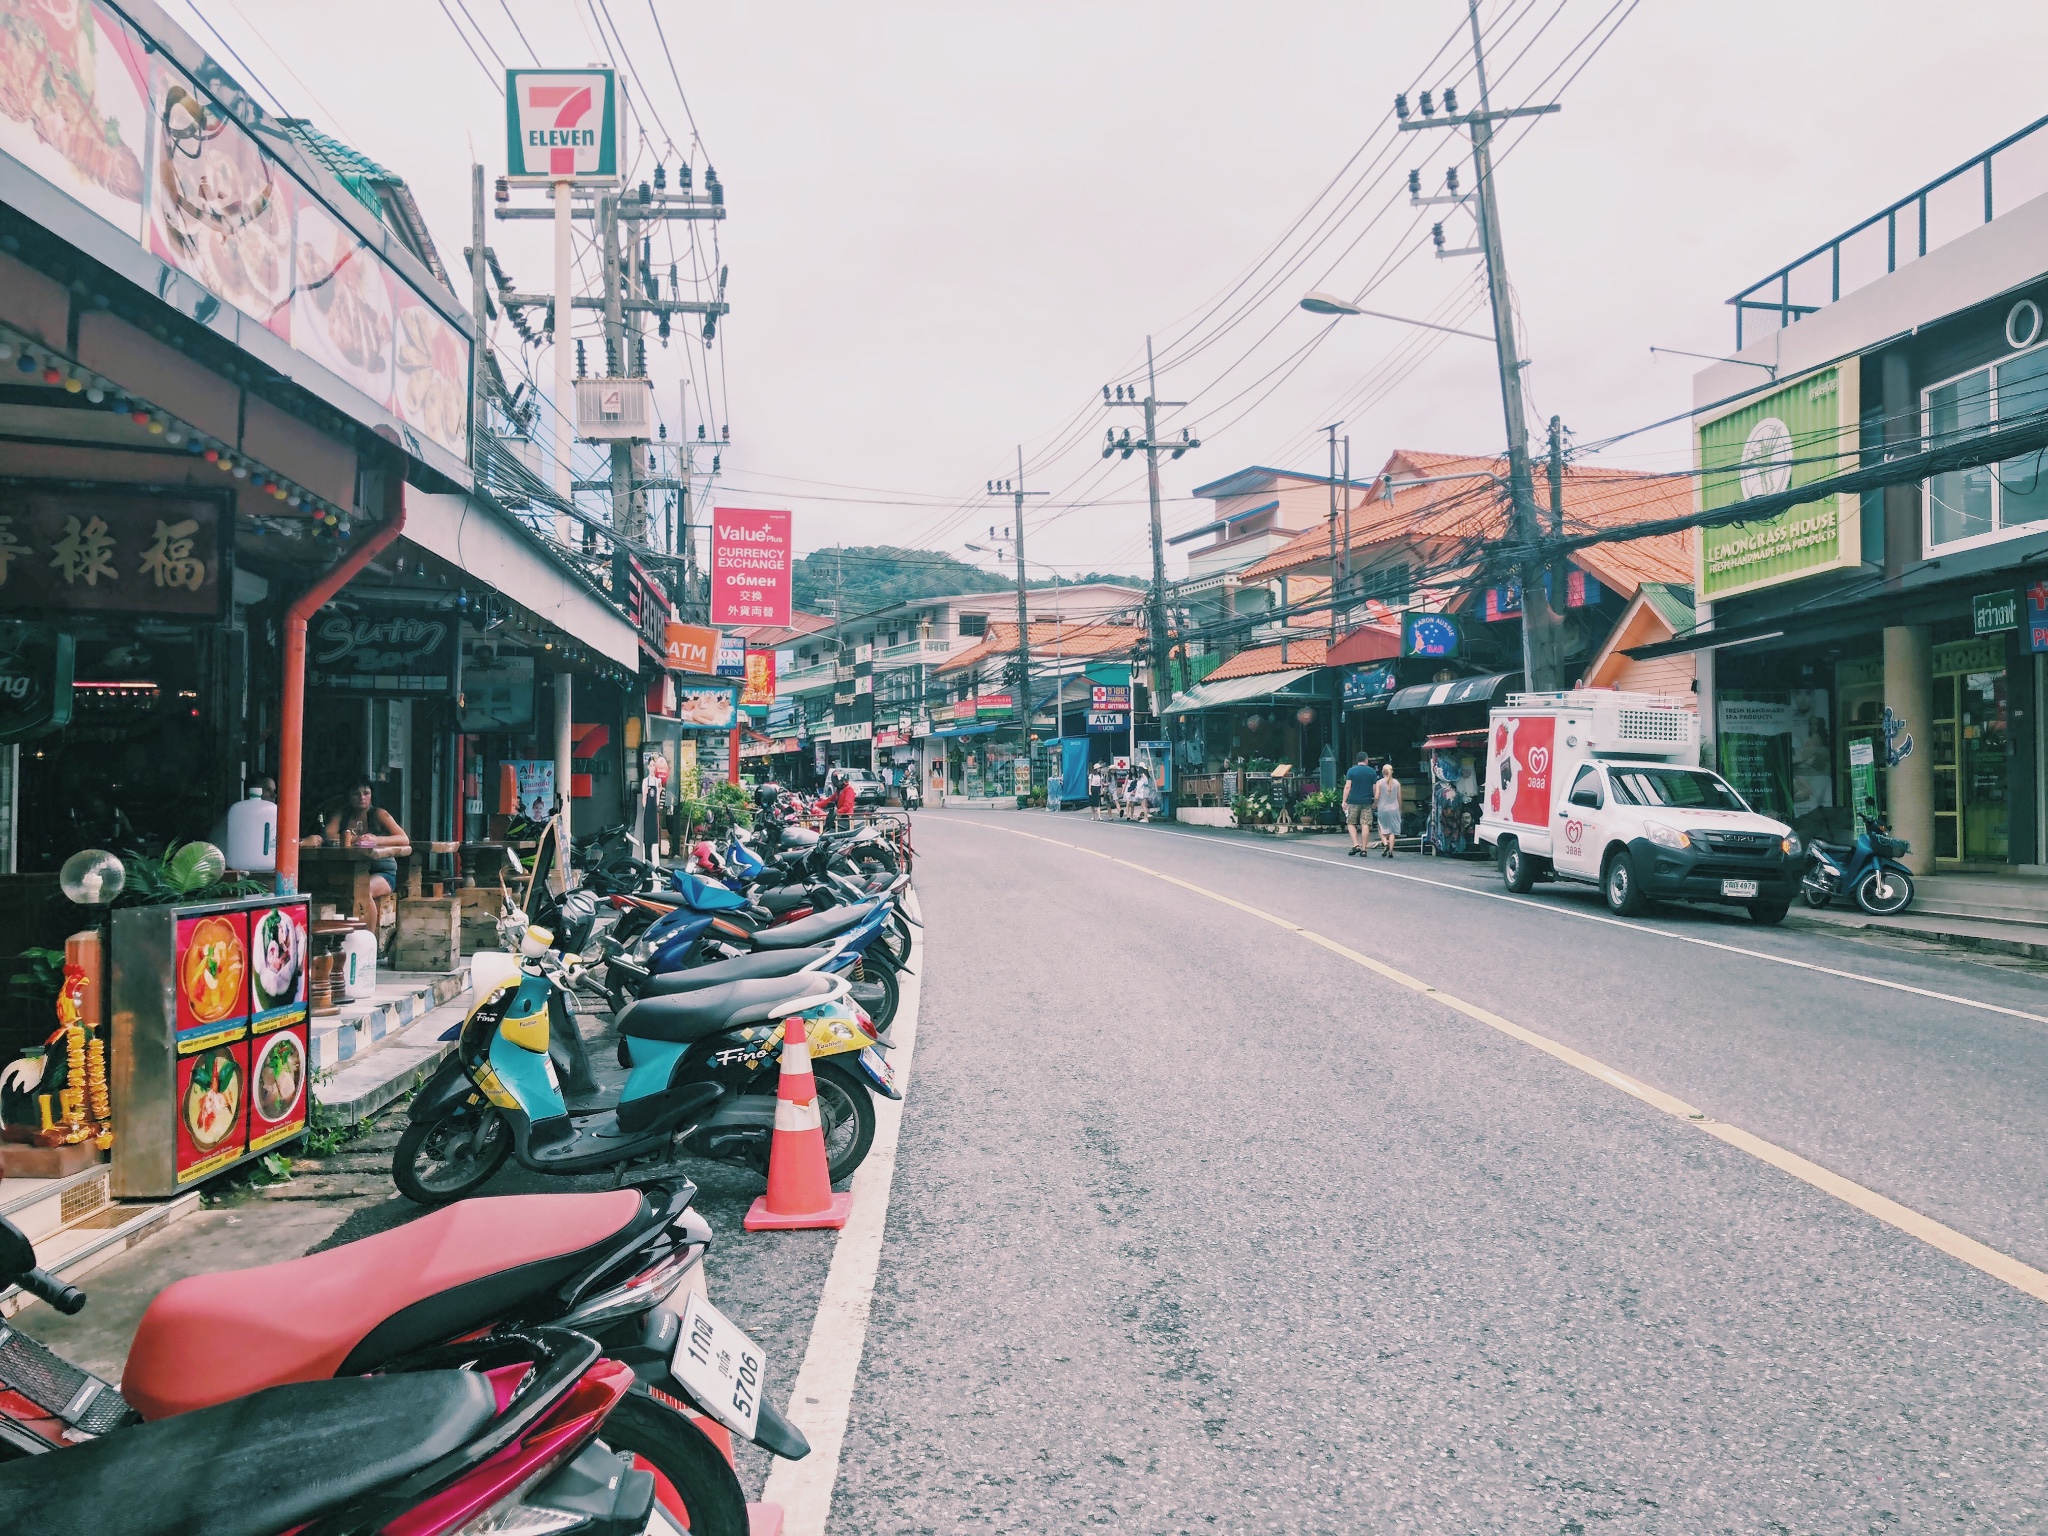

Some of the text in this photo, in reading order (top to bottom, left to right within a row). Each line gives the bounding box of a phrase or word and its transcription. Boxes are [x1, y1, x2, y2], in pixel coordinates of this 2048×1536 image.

[529, 86, 591, 174] 7
[766, 535, 783, 543] Plus
[1708, 511, 1836, 561] LEMONGRASS HOUSE
[718, 547, 785, 559] CURRENCY
[1709, 528, 1837, 574] FRESH HANDMADE SPA PRODUCTS
[718, 558, 785, 570] EXCHANGE
[726, 573, 777, 587] обмен
[1413, 617, 1455, 637] KARON AUSSIE
[668, 641, 707, 662] ATM
[1426, 644, 1445, 654] BAR
[725, 668, 744, 676] RENT
[692, 689, 734, 697] MASSAGE
[1095, 715, 1117, 724] ATM
[519, 762, 535, 774] All
[1723, 834, 1754, 842] ISUZU
[476, 1012, 496, 1022] Fino
[715, 1047, 769, 1066] Fino
[658, 1314, 670, 1340] HONDA
[715, 1349, 733, 1380] ภูเก็ต
[732, 1351, 759, 1419] 5706
[71, 1385, 97, 1413] HONDA
